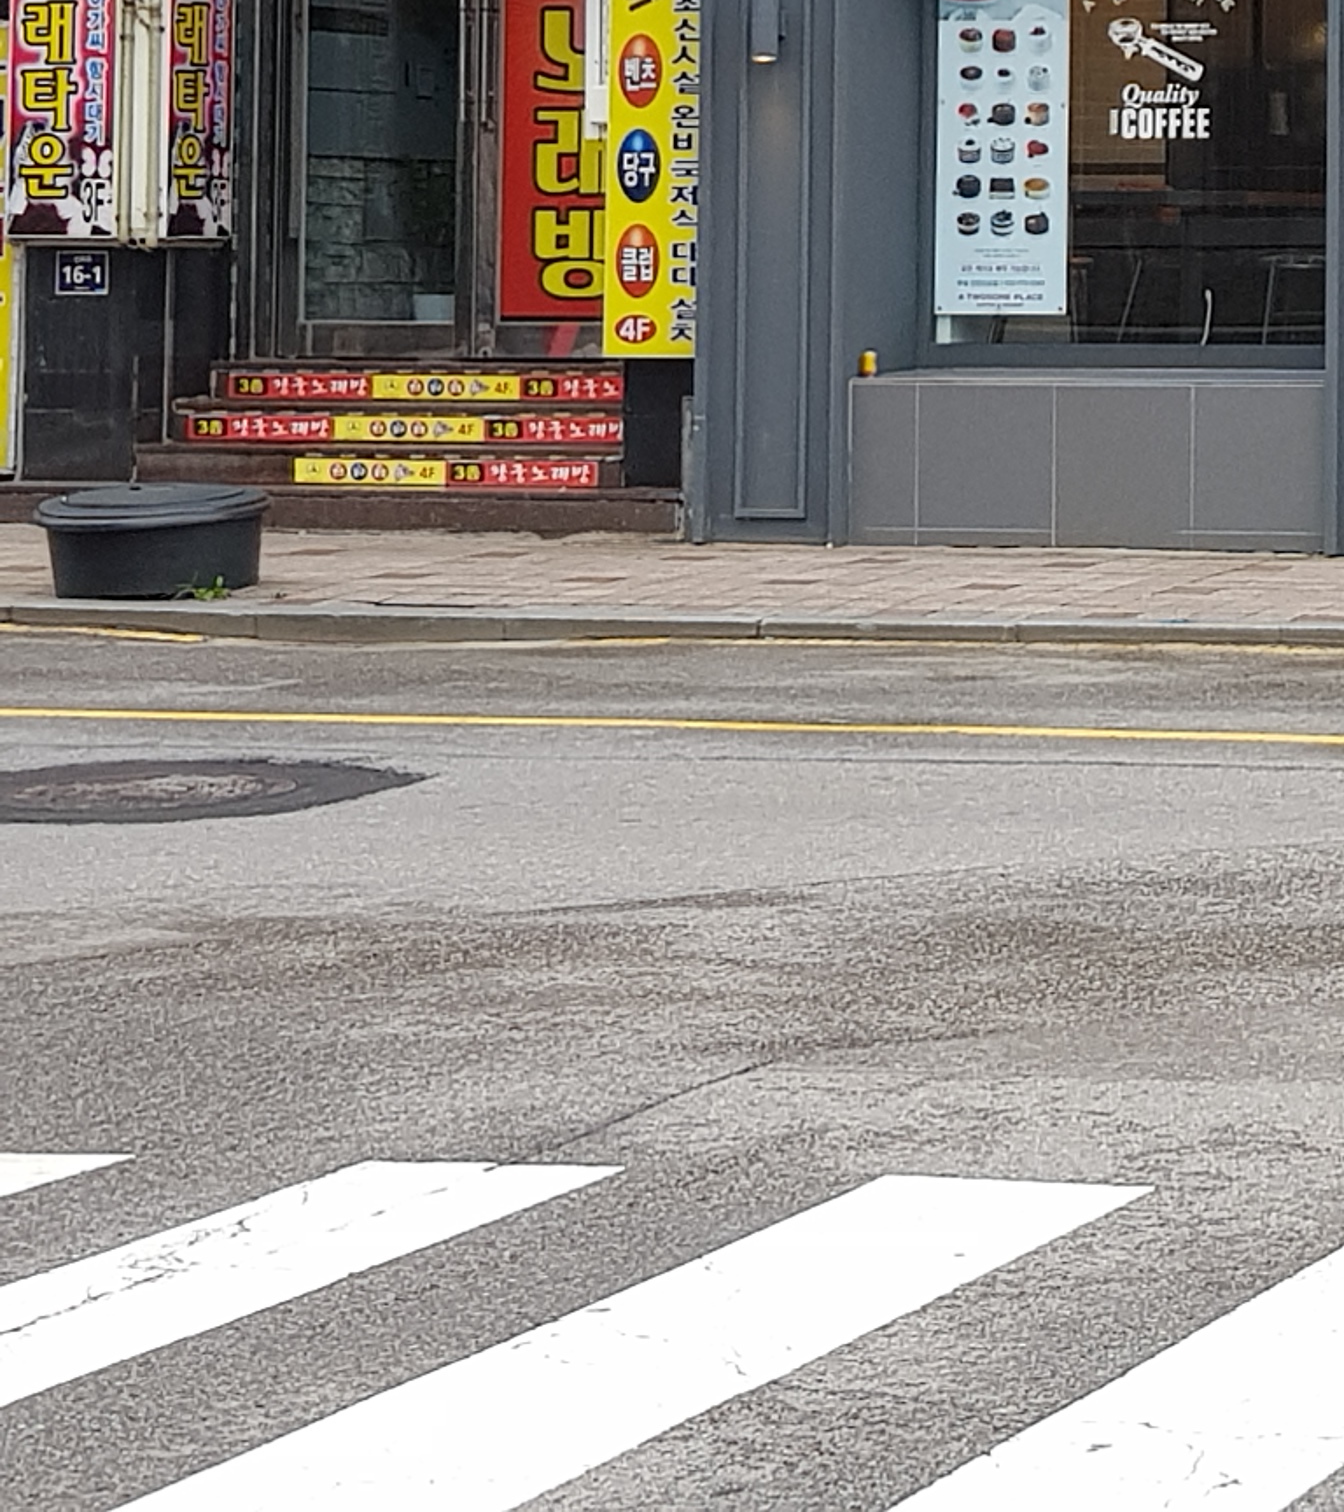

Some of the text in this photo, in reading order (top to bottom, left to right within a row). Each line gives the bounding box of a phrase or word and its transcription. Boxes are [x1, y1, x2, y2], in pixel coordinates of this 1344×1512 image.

[623, 56, 657, 92] 벤츠
[1121, 83, 1200, 108] Quality
[1120, 107, 1211, 140] COFFEE
[622, 151, 656, 187] 당구
[62, 264, 102, 284] 16-1
[620, 246, 654, 282] 클럽
[619, 317, 651, 341] 4F
